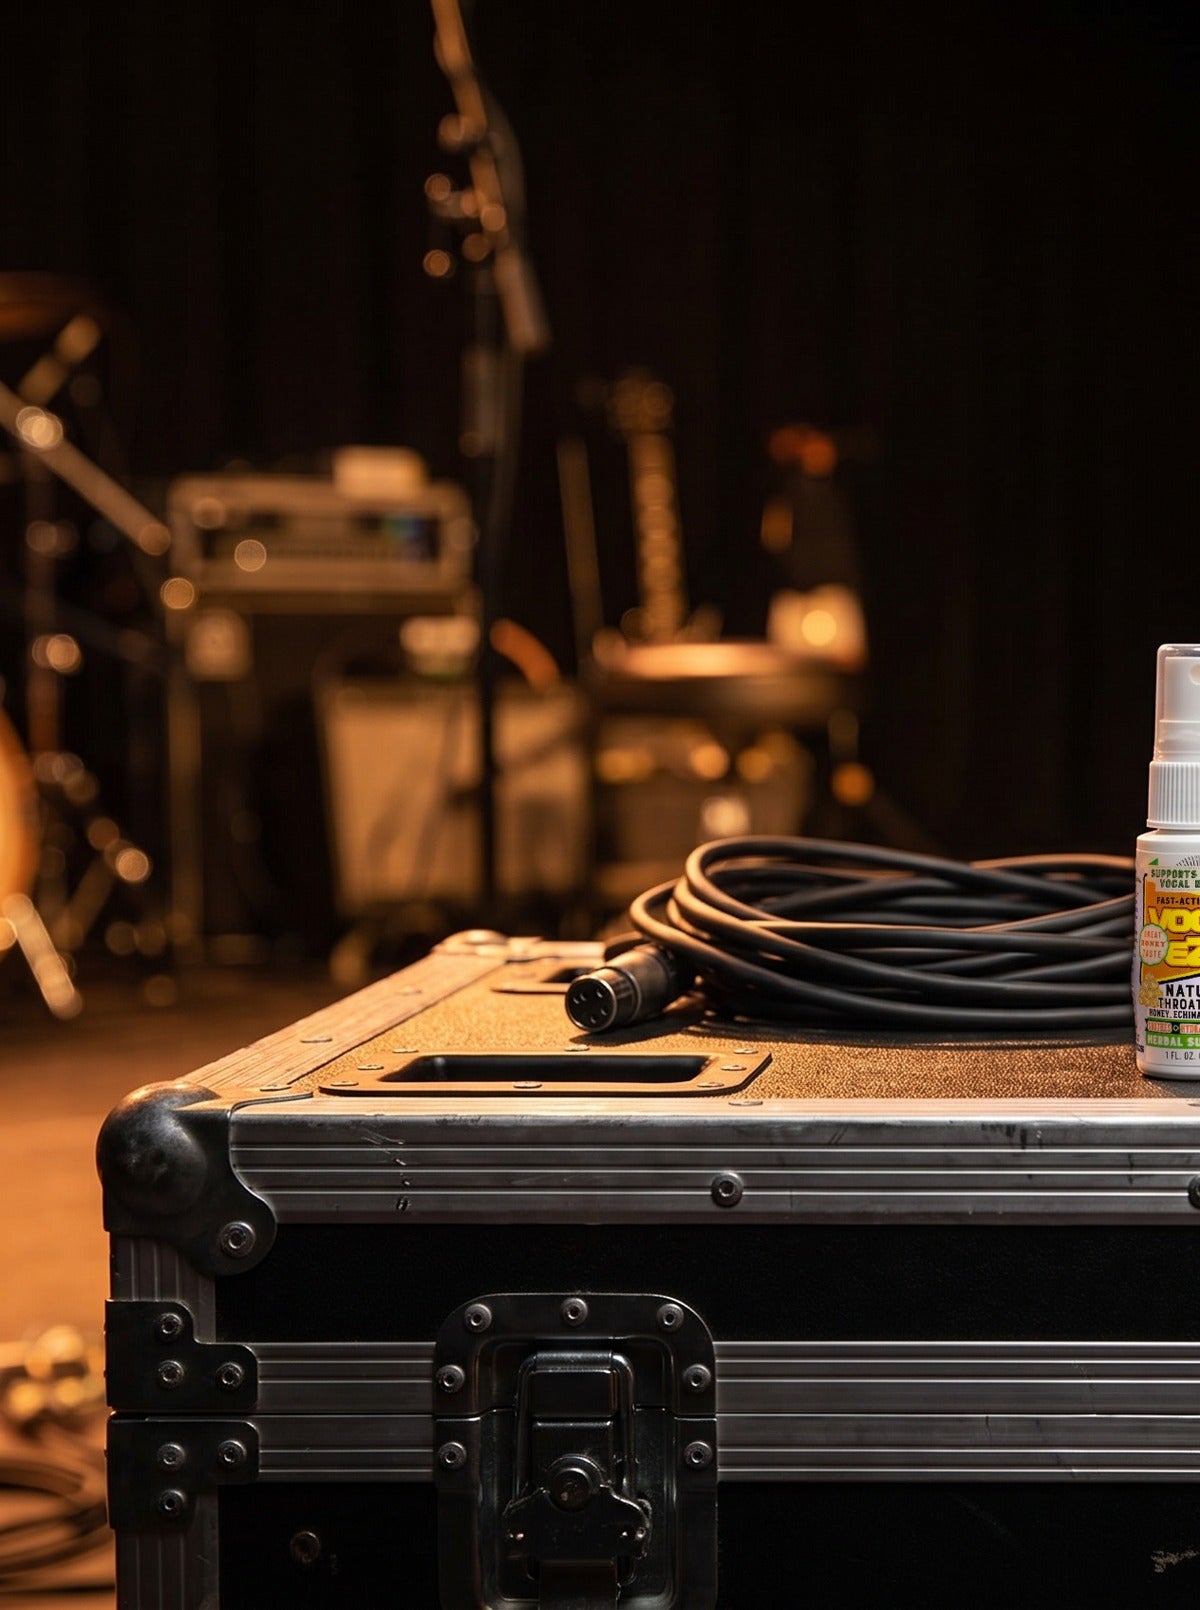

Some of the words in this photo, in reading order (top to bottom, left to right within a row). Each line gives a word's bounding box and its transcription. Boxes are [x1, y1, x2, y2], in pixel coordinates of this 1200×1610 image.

[1151, 869, 1197, 878] SUPPORTS
[1160, 879, 1190, 889] VOCAL
[1147, 1034, 1183, 1046] HERBAL
